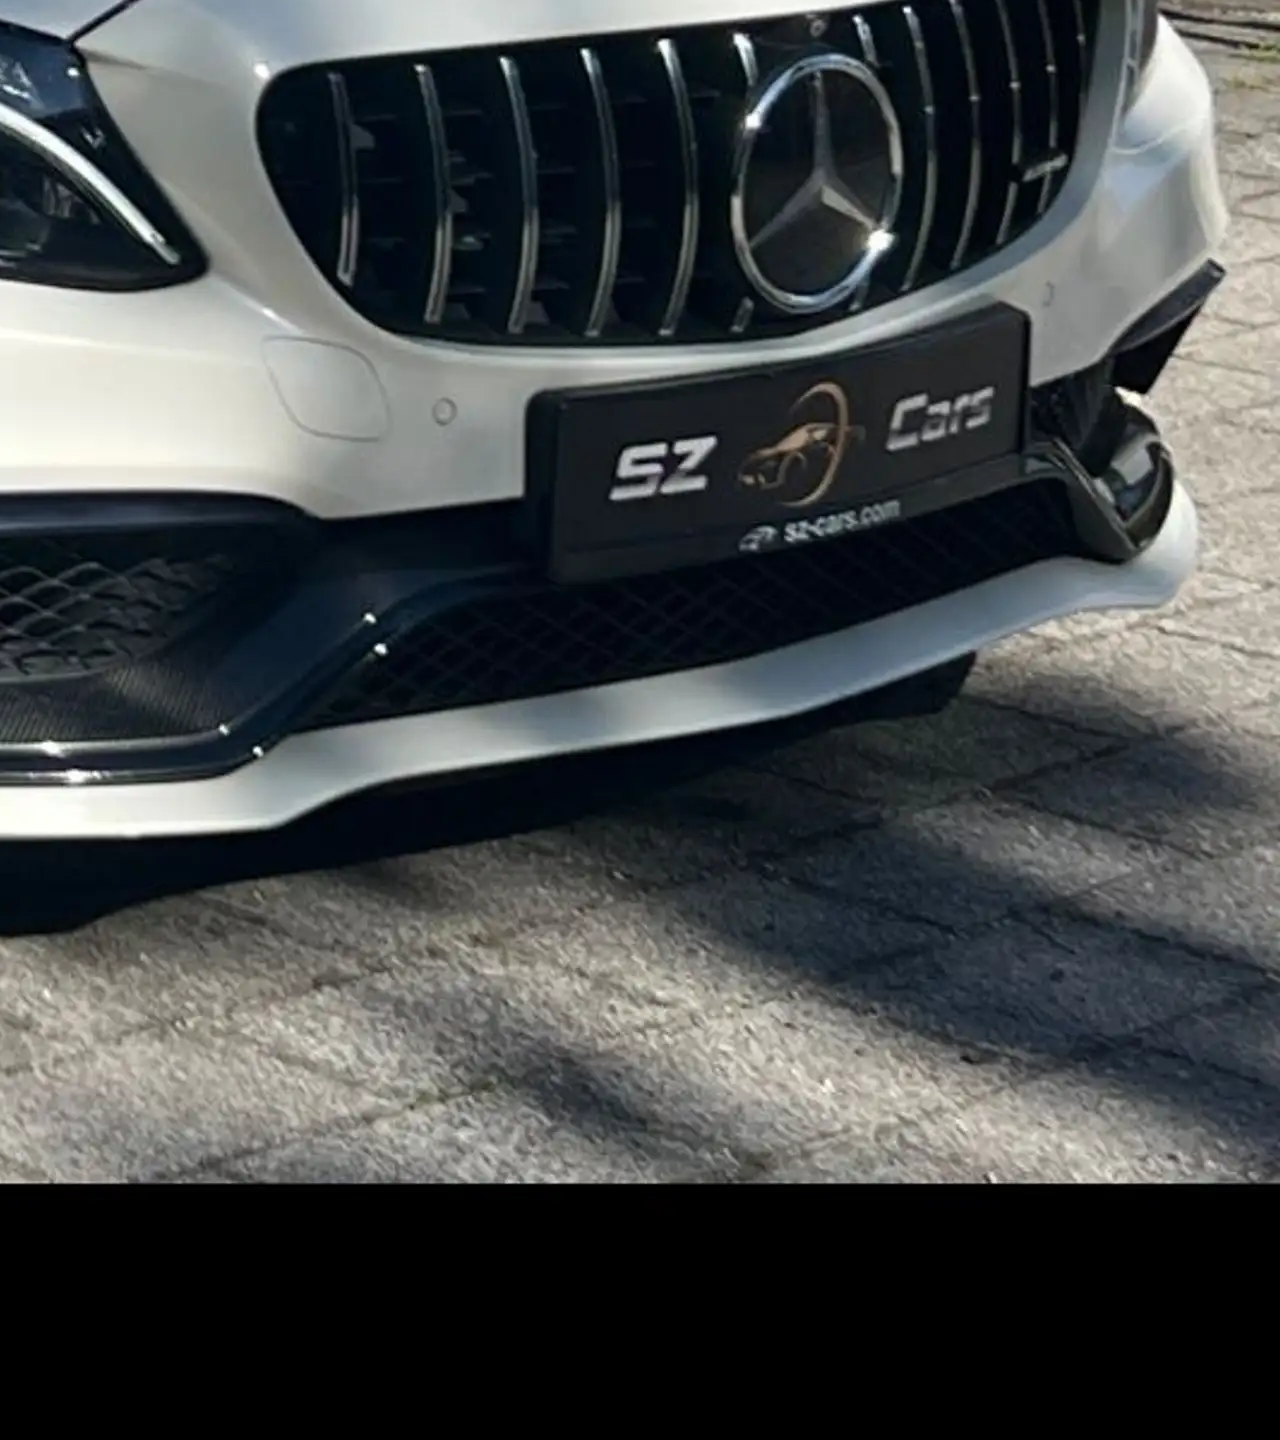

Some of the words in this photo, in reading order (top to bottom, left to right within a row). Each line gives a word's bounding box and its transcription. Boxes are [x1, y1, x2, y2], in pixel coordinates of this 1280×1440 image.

[608, 435, 718, 501] SZ
[885, 386, 995, 452] Cars
[782, 498, 901, 545] sz-cars.com
